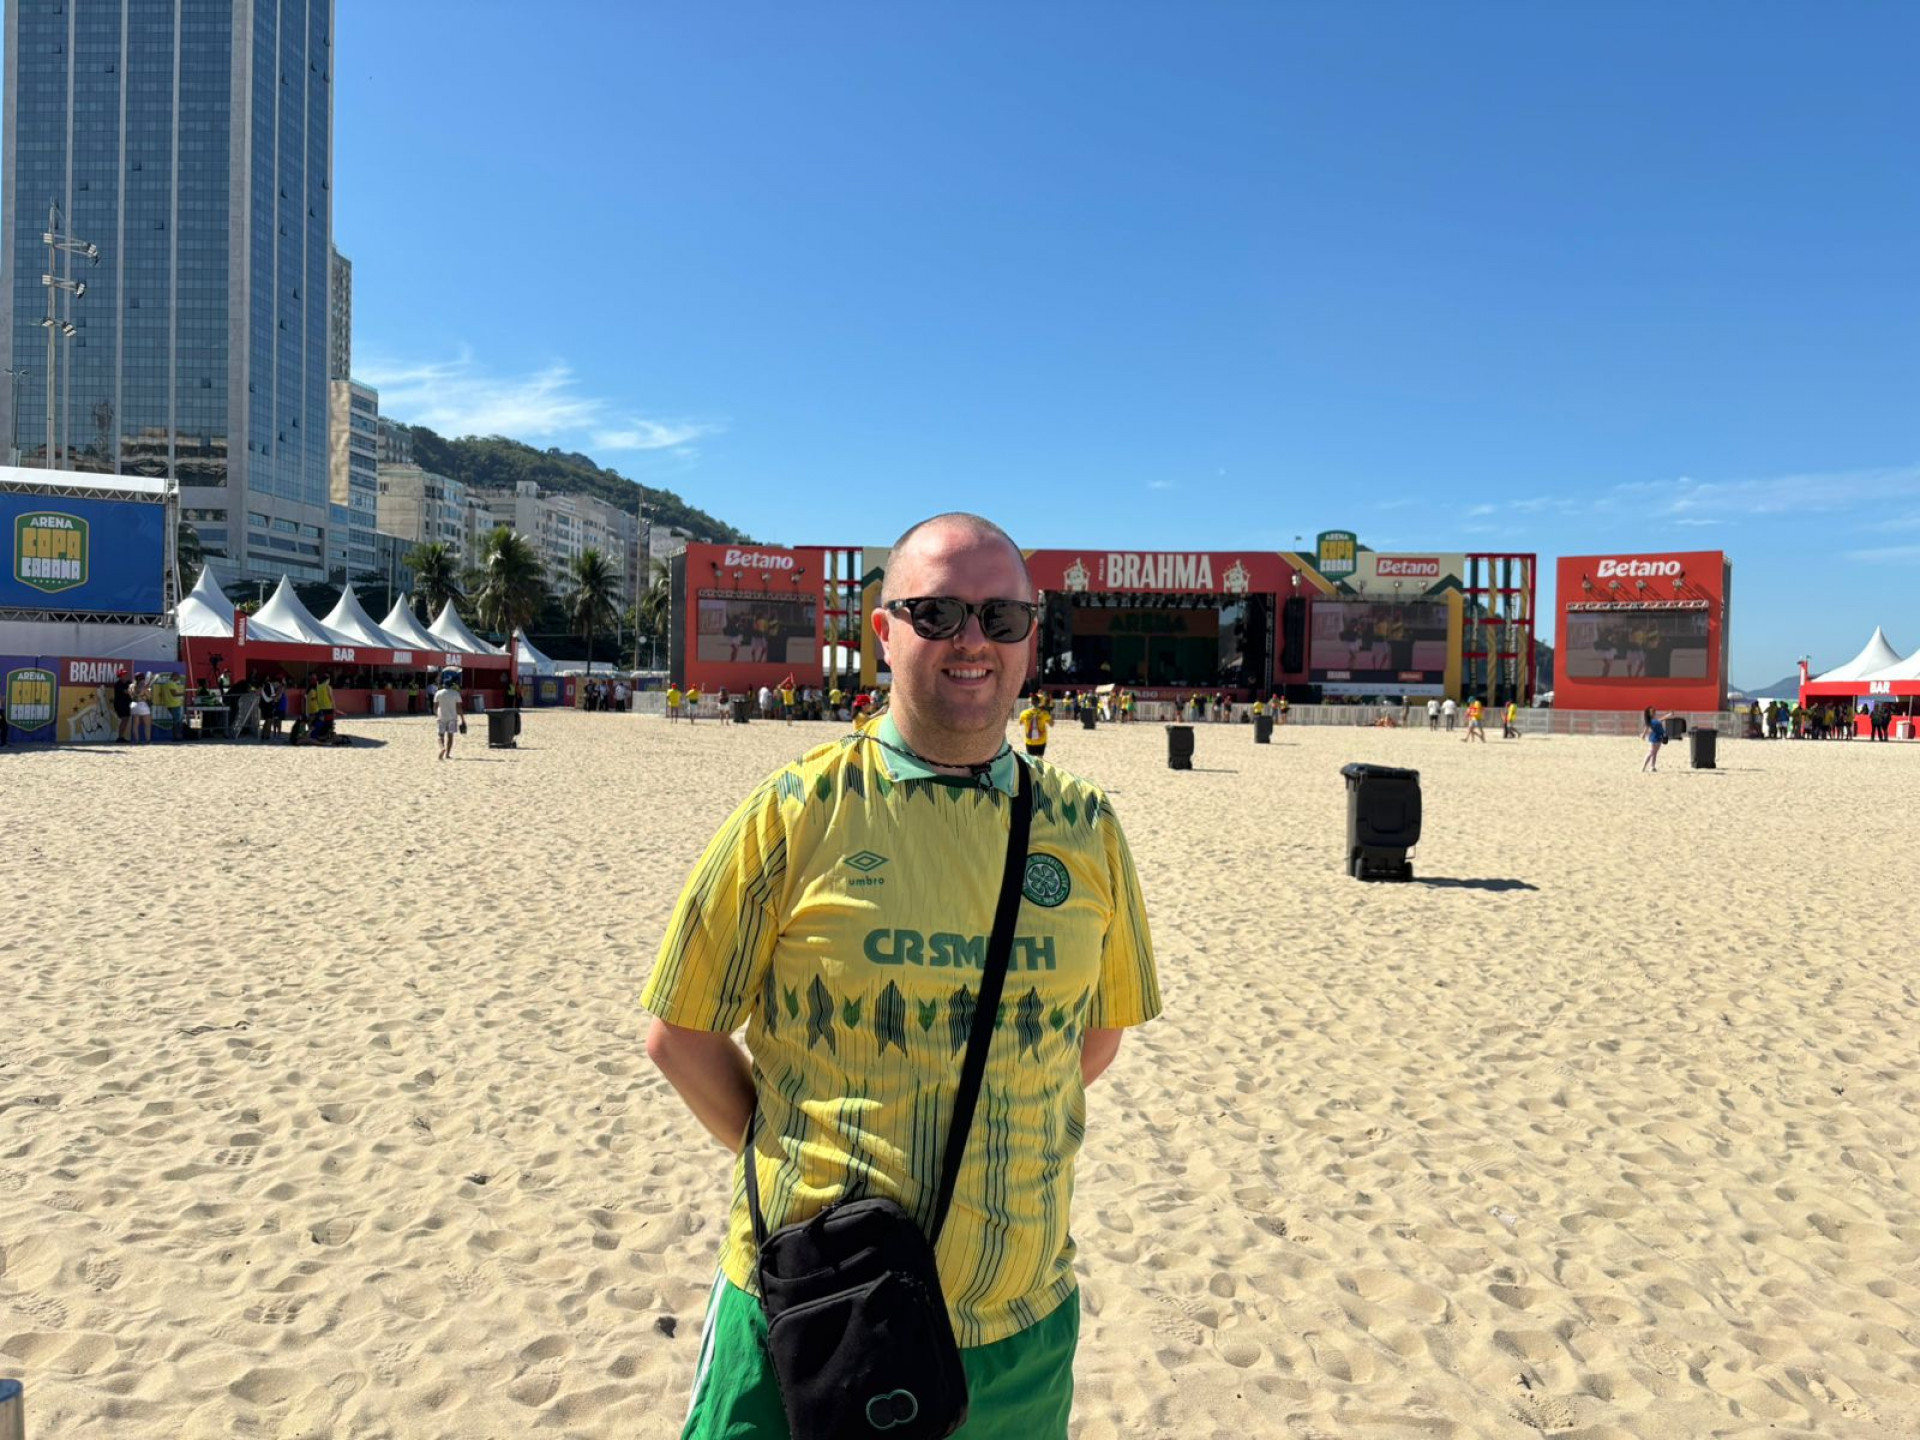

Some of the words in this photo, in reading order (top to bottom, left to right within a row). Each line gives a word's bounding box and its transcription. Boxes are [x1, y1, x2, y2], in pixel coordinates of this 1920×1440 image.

[30, 516, 74, 529] ARENA
[22, 527, 82, 559] COPA
[724, 549, 794, 570] Betano
[1379, 559, 1438, 574] Betano
[21, 557, 81, 580] CABANA
[1107, 553, 1213, 589] BRAHMA
[1597, 559, 1681, 578] Betano
[332, 647, 355, 661] BAR
[446, 653, 462, 665] BAR
[18, 672, 46, 680] ARENA
[1870, 681, 1890, 694] BAR
[848, 875, 885, 885] umbro
[929, 932, 1057, 971] SMTH
